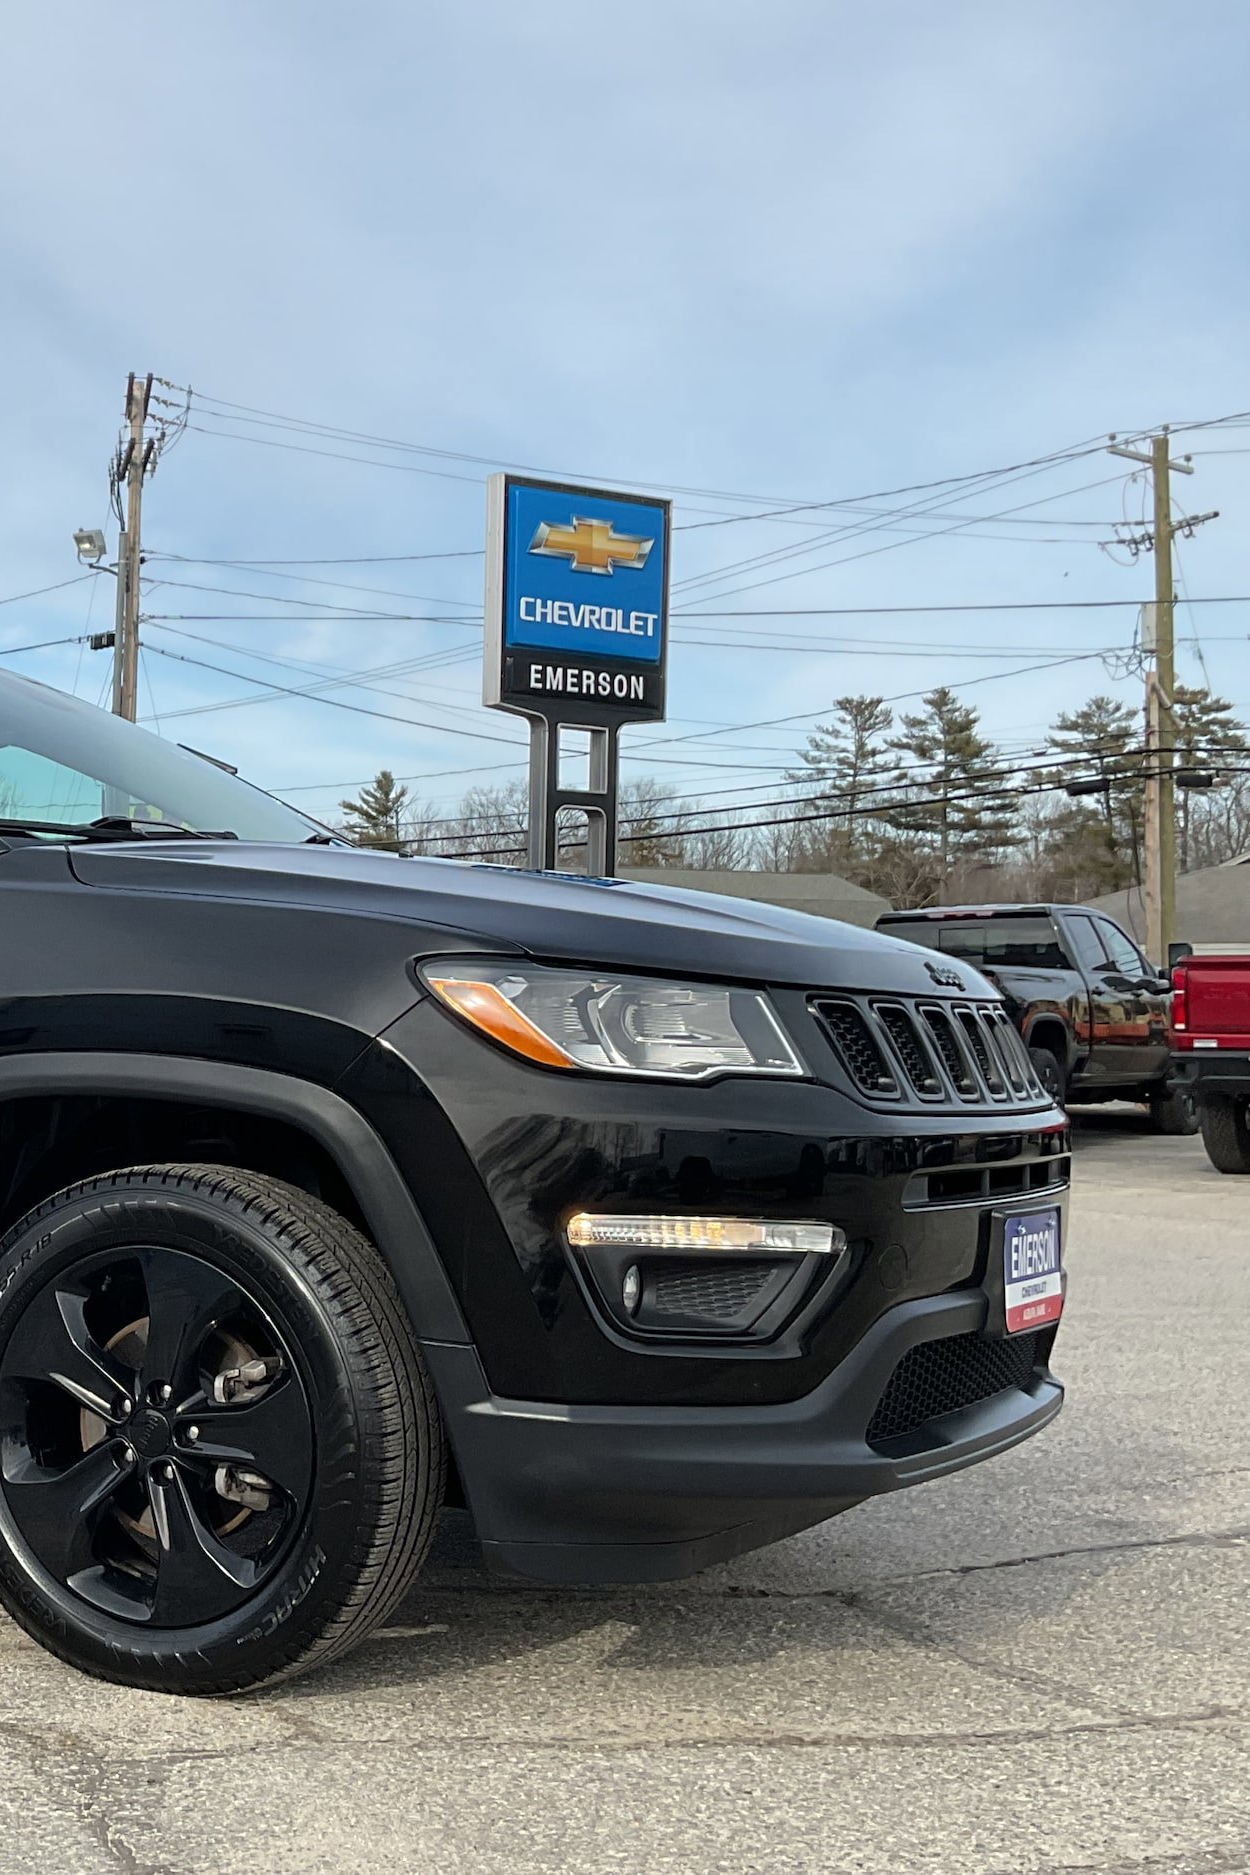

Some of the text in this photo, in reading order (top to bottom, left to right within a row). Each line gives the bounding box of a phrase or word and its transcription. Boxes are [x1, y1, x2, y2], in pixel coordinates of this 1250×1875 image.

[519, 596, 658, 637] CHEVROLET
[529, 663, 644, 700] EMERSON
[923, 961, 966, 991] Jeep
[1011, 1228, 1055, 1279] EMERSON
